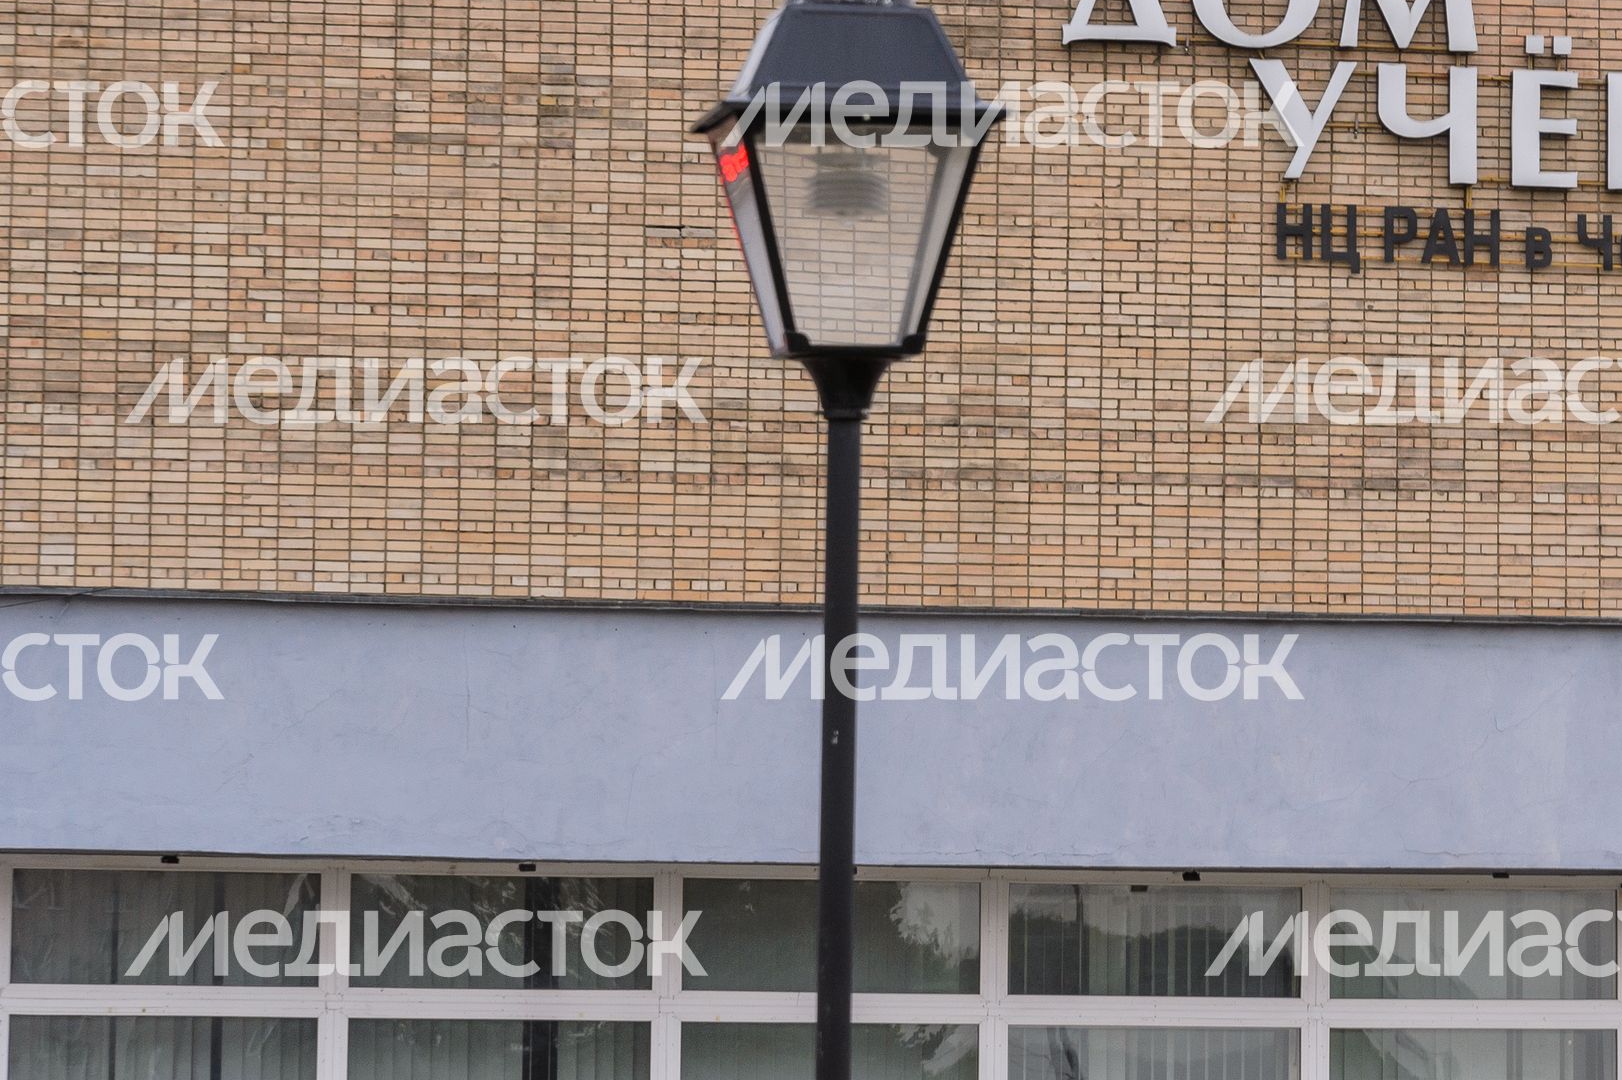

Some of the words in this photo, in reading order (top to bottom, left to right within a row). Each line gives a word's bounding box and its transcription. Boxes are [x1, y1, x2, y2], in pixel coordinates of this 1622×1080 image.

[1275, 202, 1361, 274] НЦ
[1383, 205, 1501, 267] РАН
[1525, 226, 1553, 270] в
